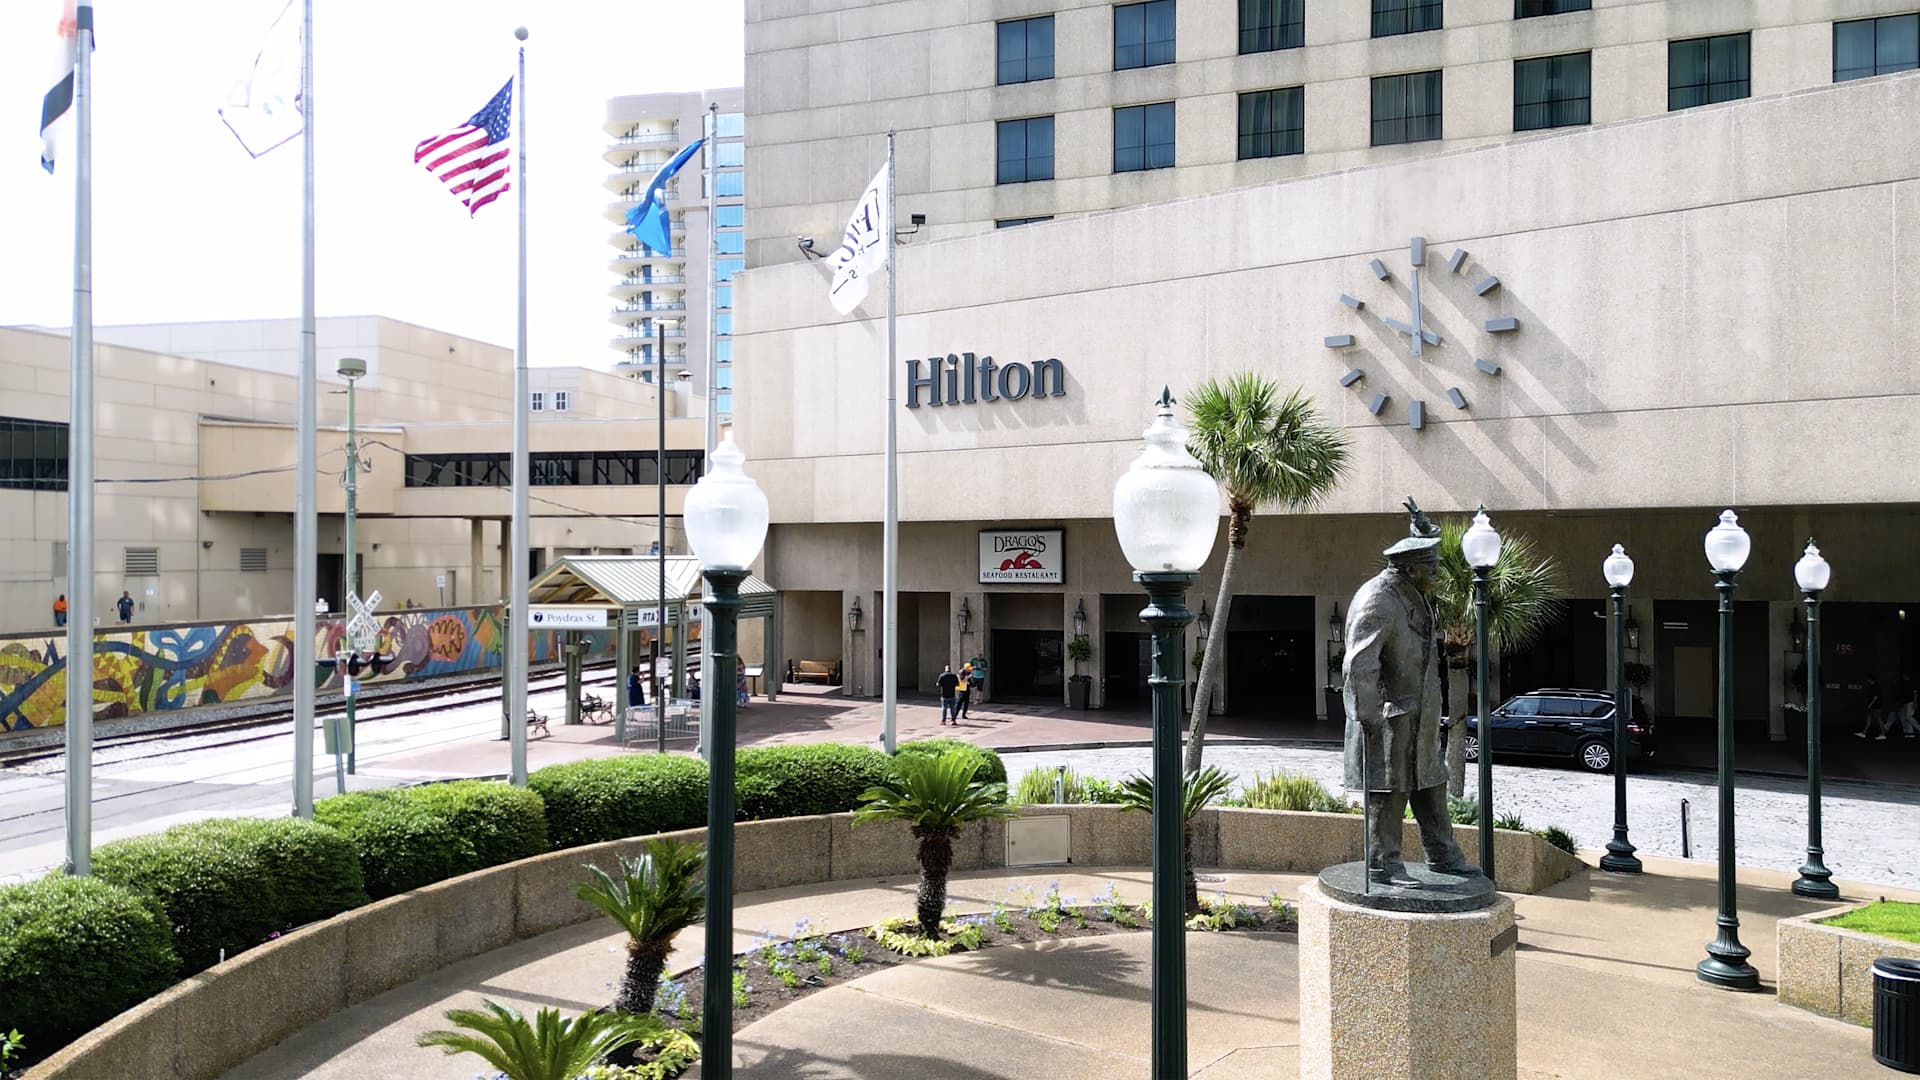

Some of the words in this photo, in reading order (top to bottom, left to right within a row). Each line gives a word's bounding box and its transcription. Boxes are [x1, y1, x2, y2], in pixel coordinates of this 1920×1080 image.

[905, 352, 1066, 409] Hilton
[994, 534, 1046, 553] DRAGO'S
[547, 613, 584, 624] Poydras
[643, 612, 655, 622] RTA
